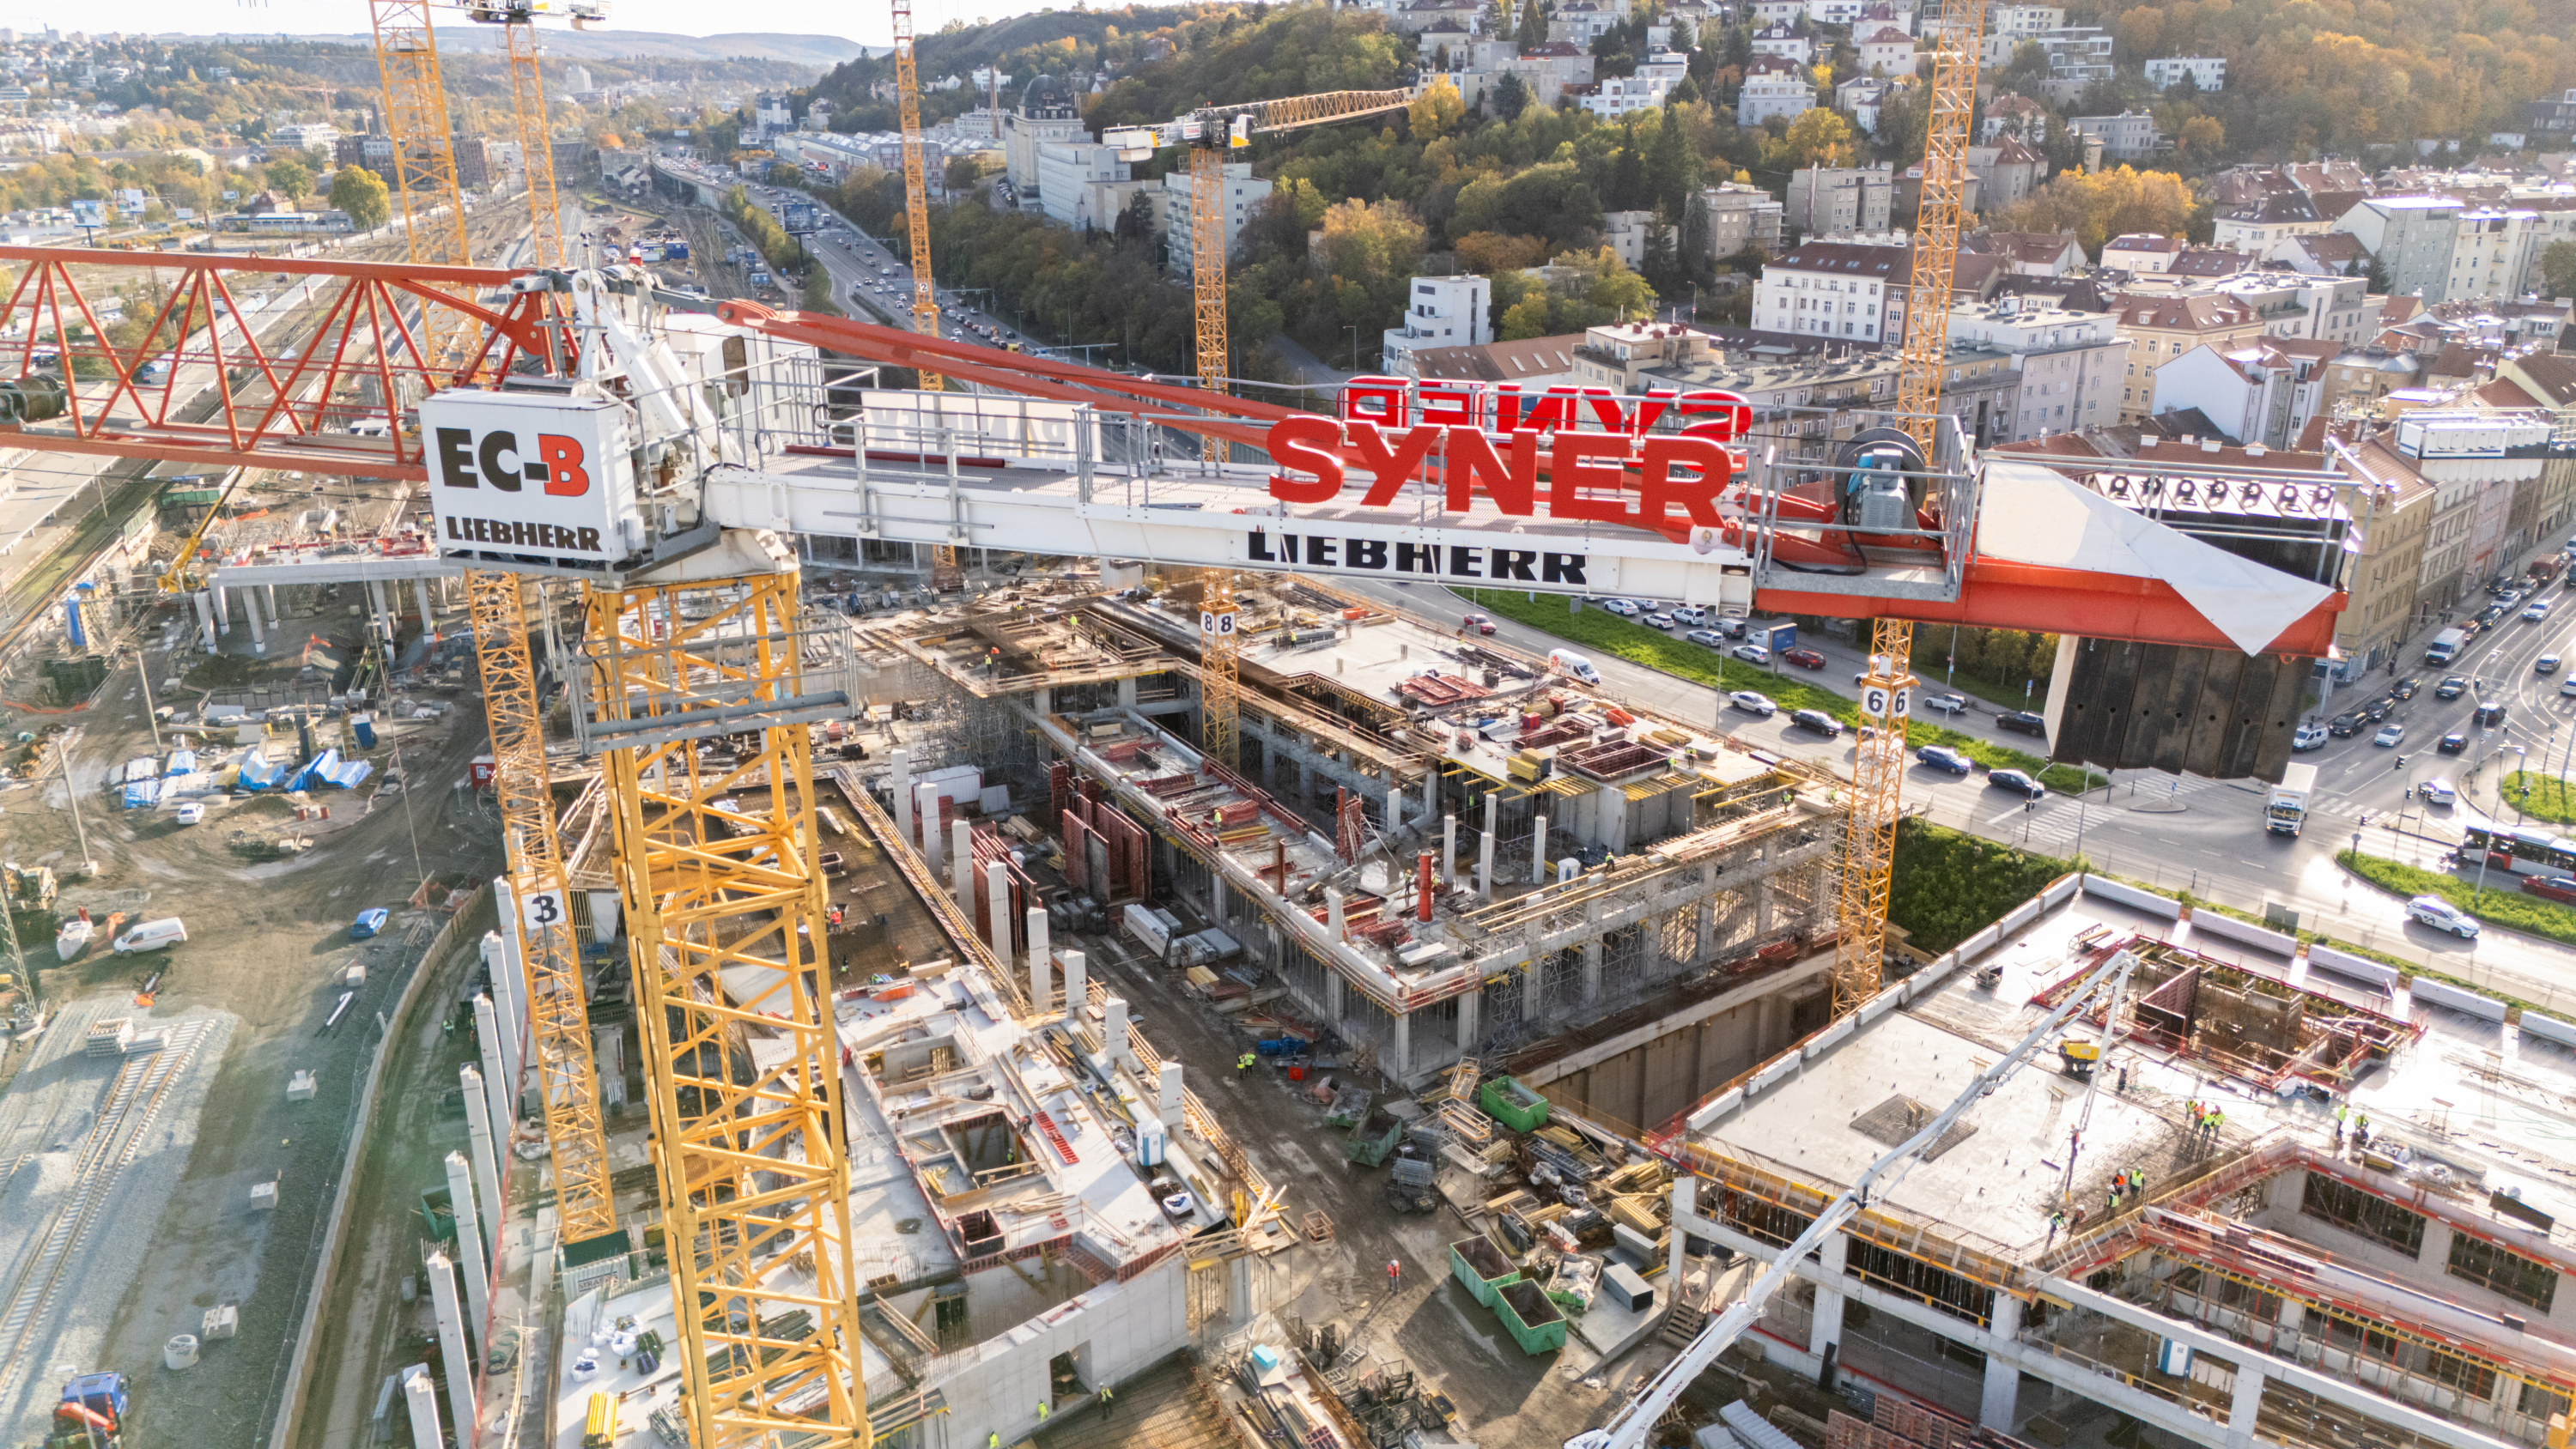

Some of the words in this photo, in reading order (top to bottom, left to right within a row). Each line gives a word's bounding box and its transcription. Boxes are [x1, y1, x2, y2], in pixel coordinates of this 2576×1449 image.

[435, 427, 590, 497] EC-B
[1266, 414, 1732, 529] SYNER
[446, 515, 603, 552] LIEBHERR
[1248, 530, 1588, 585] LIEBHERR
[1205, 614, 1212, 632] 8
[1220, 615, 1232, 633] 8
[1868, 690, 1884, 712] 6
[1895, 691, 1906, 713] 6
[532, 895, 558, 923] 3
[577, 1274, 618, 1289] STRA
